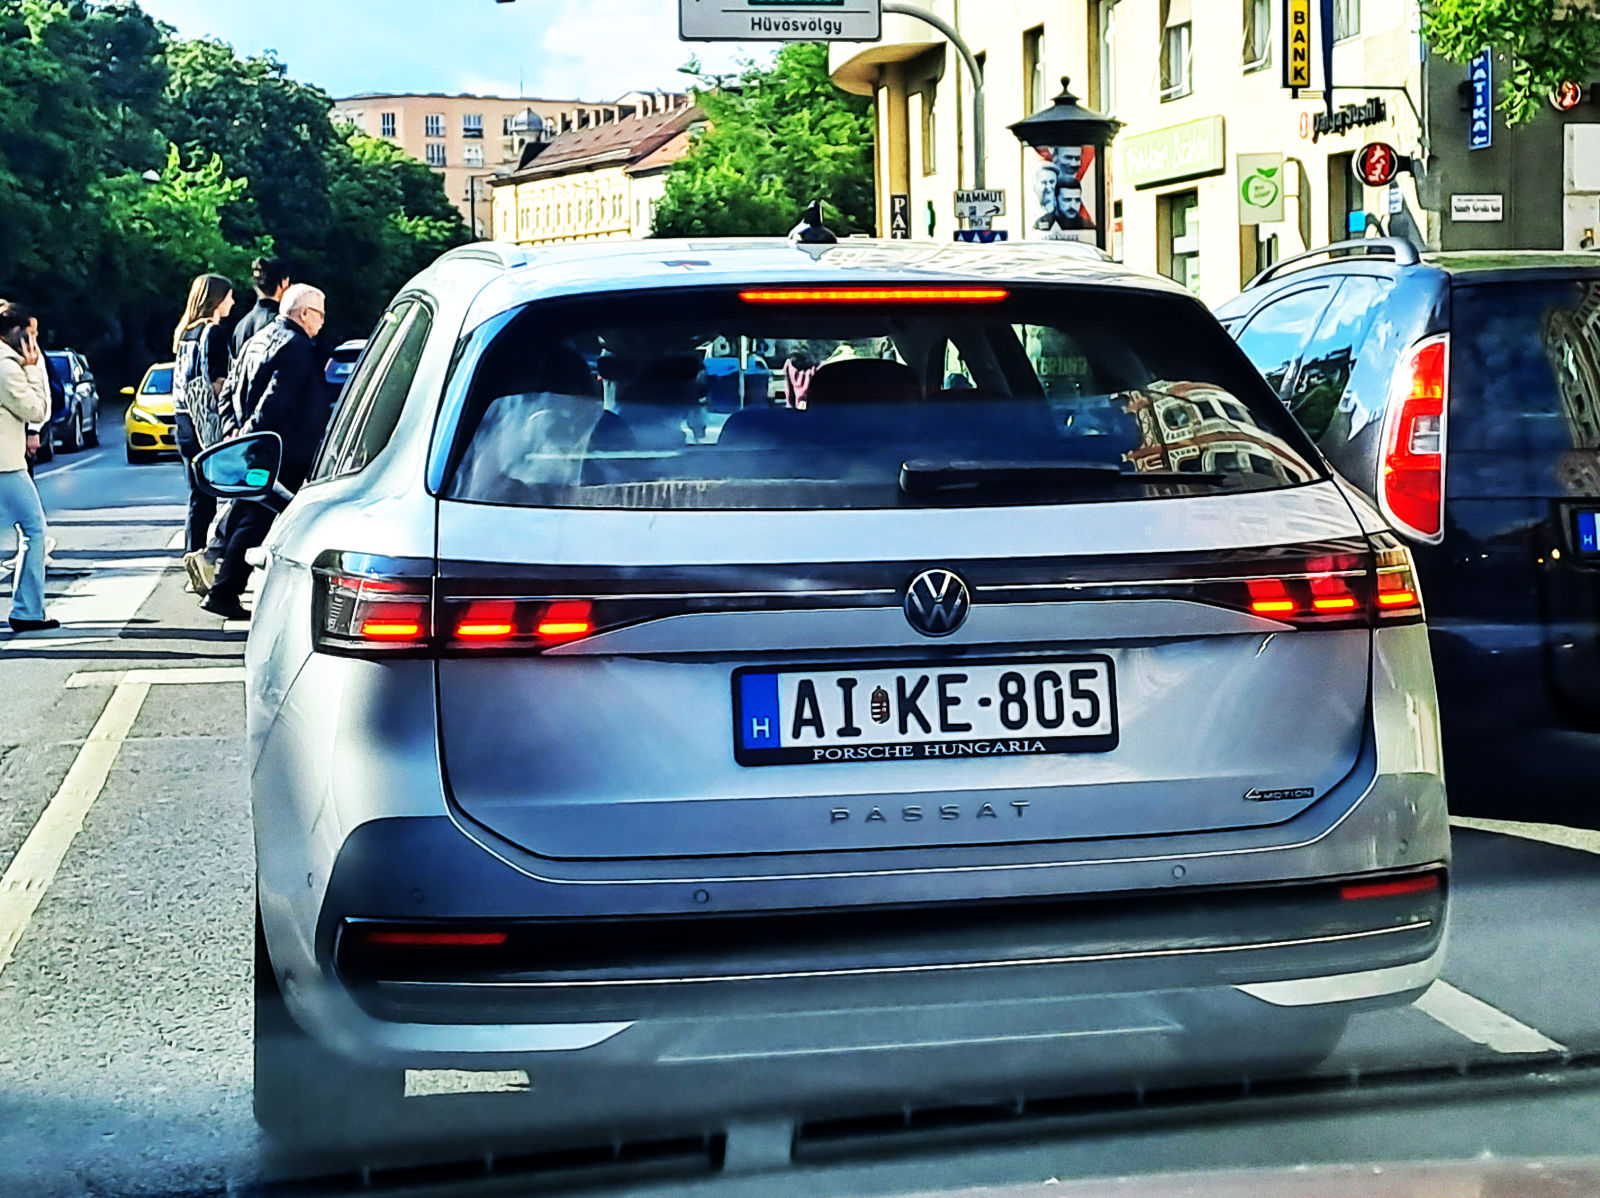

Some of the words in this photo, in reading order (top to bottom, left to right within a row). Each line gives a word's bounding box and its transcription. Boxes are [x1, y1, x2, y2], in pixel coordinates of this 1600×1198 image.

[1293, 10, 1306, 81] BANK
[956, 191, 1003, 203] MAMMUT
[1583, 534, 1593, 545] H
[791, 677, 861, 739] AI
[896, 669, 1101, 735] KE-805
[752, 717, 770, 739] H
[812, 745, 914, 761] PORSCHE
[924, 740, 1047, 756] HUNGARIA
[829, 800, 1031, 825] PASSAT
